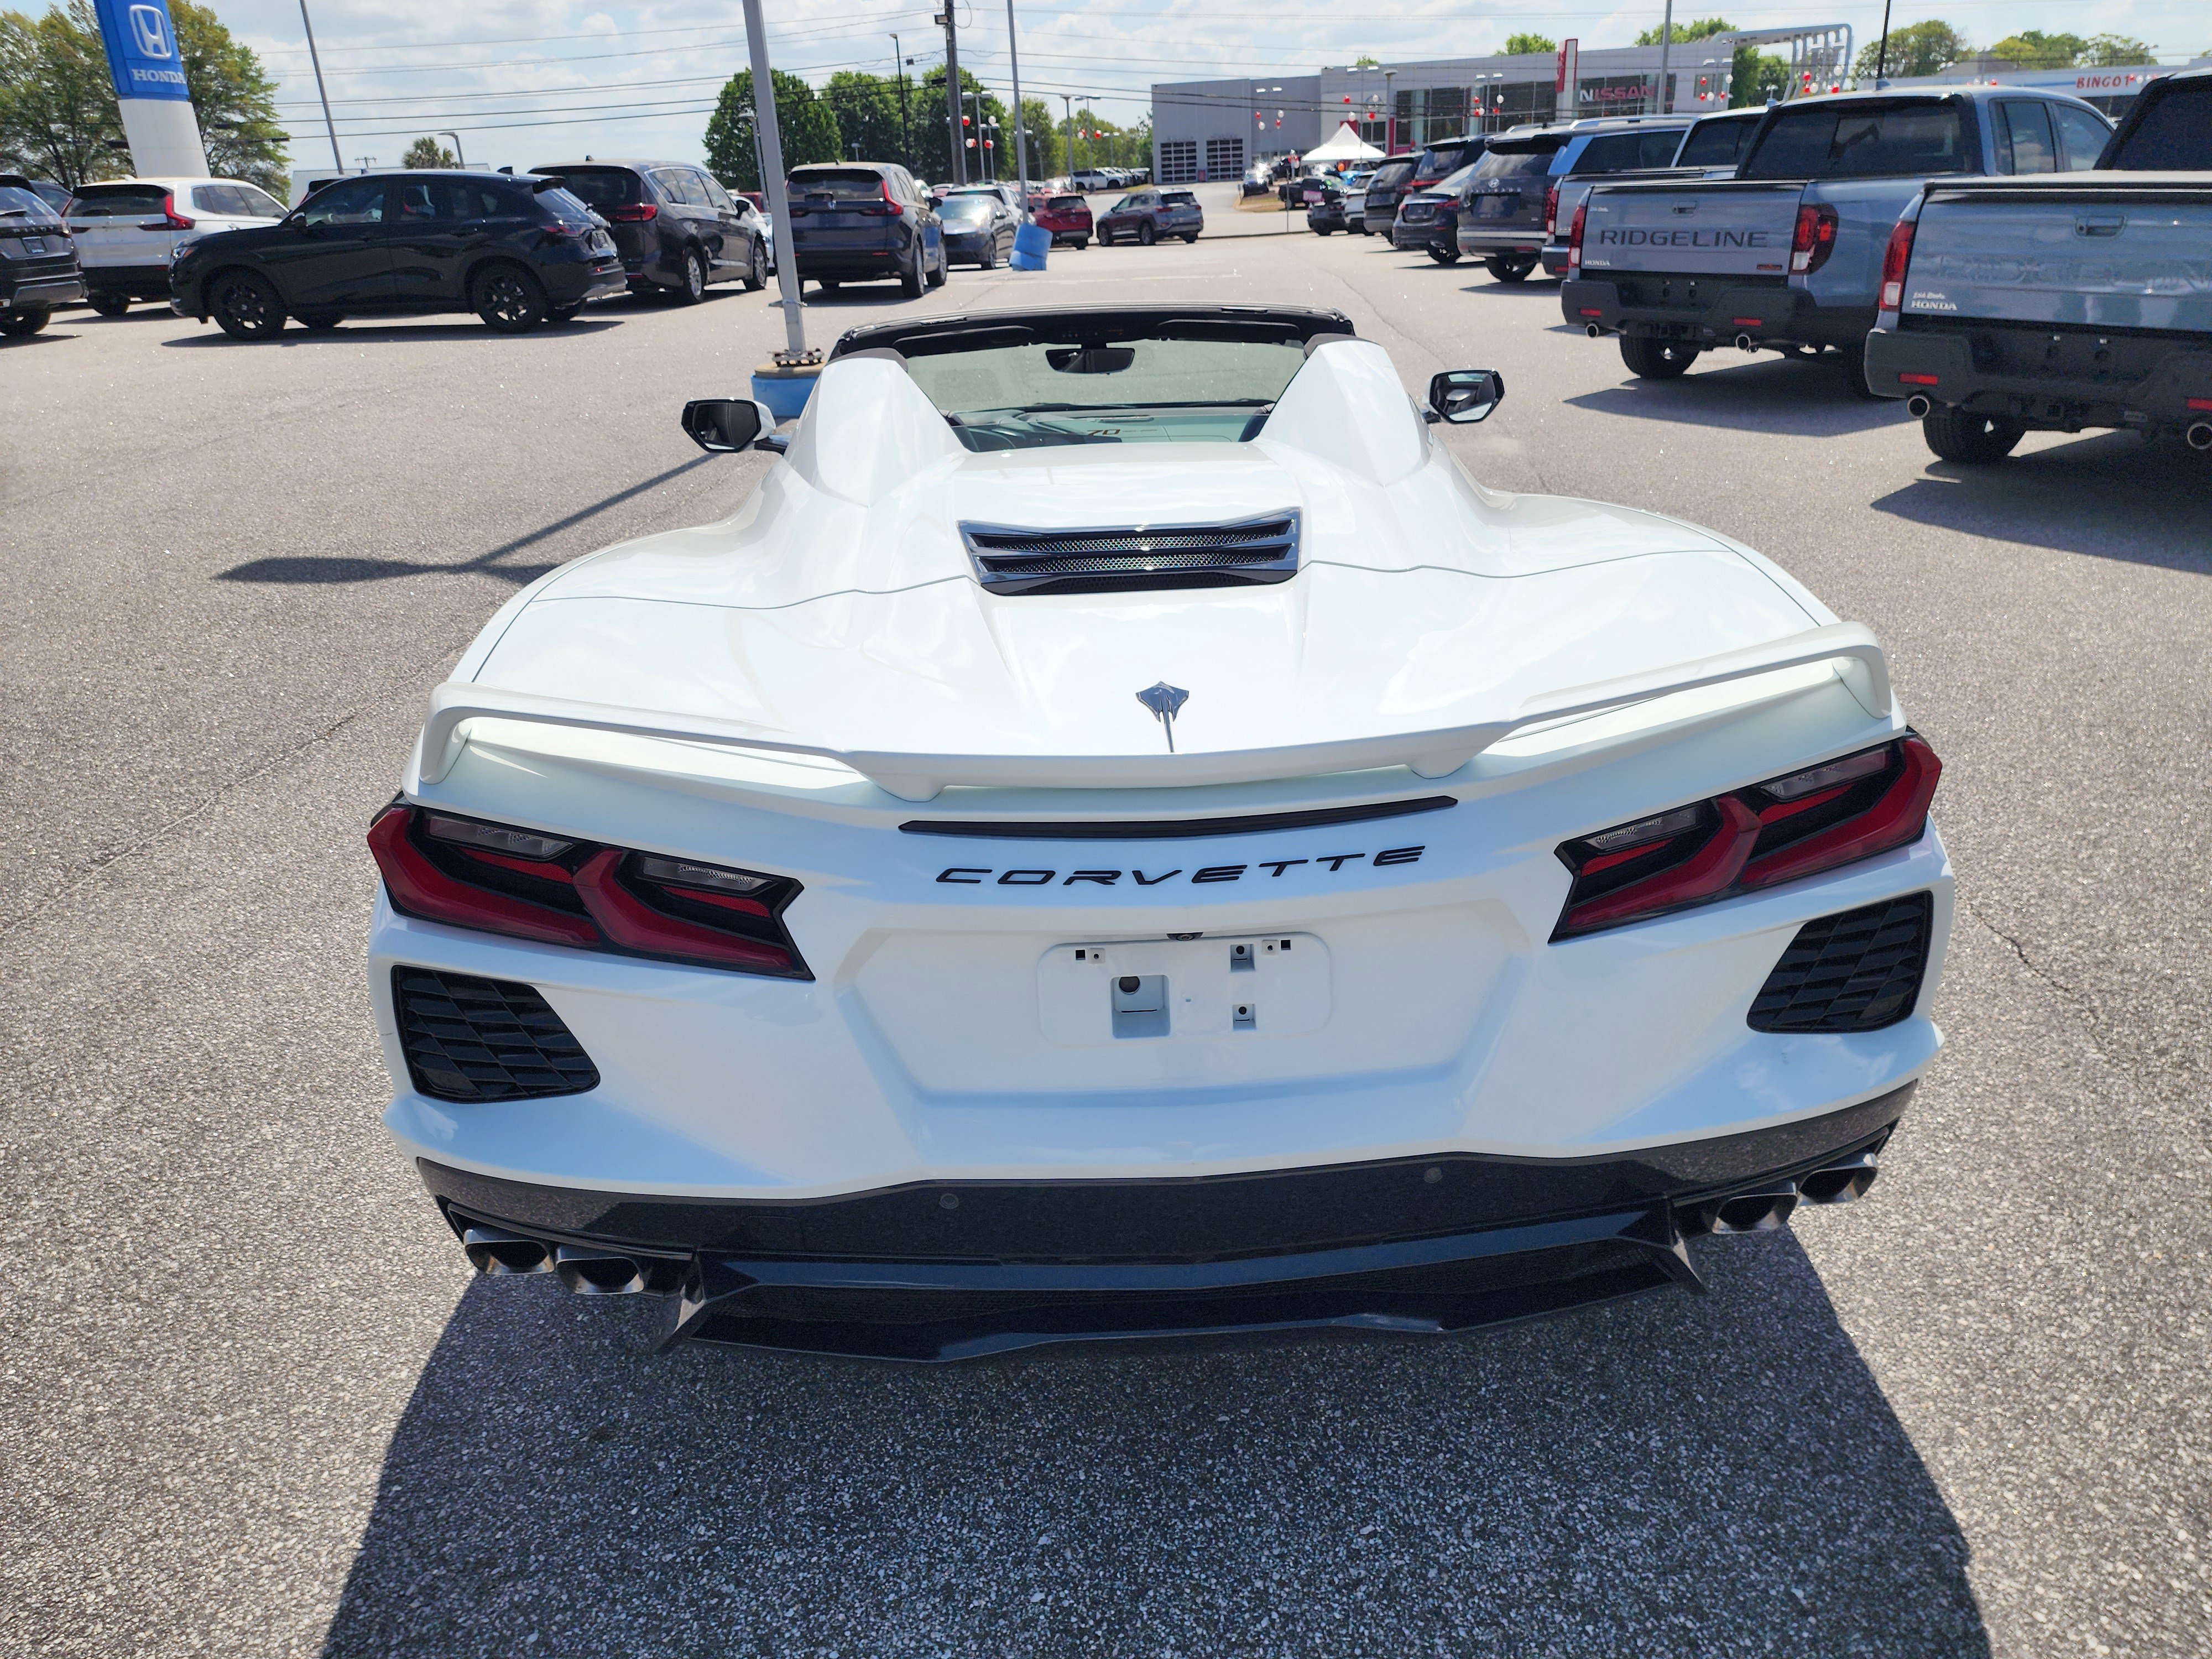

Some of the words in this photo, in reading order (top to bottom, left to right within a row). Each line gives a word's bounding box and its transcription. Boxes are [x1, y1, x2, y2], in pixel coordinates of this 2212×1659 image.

[132, 69, 186, 84] HONDA
[2076, 75, 2122, 89] BINGO
[1579, 85, 1655, 102] NISSAN
[1600, 229, 1769, 247] RIDGELINE
[1911, 300, 1958, 311] HONDA
[935, 845, 1426, 885] CORVETTE
